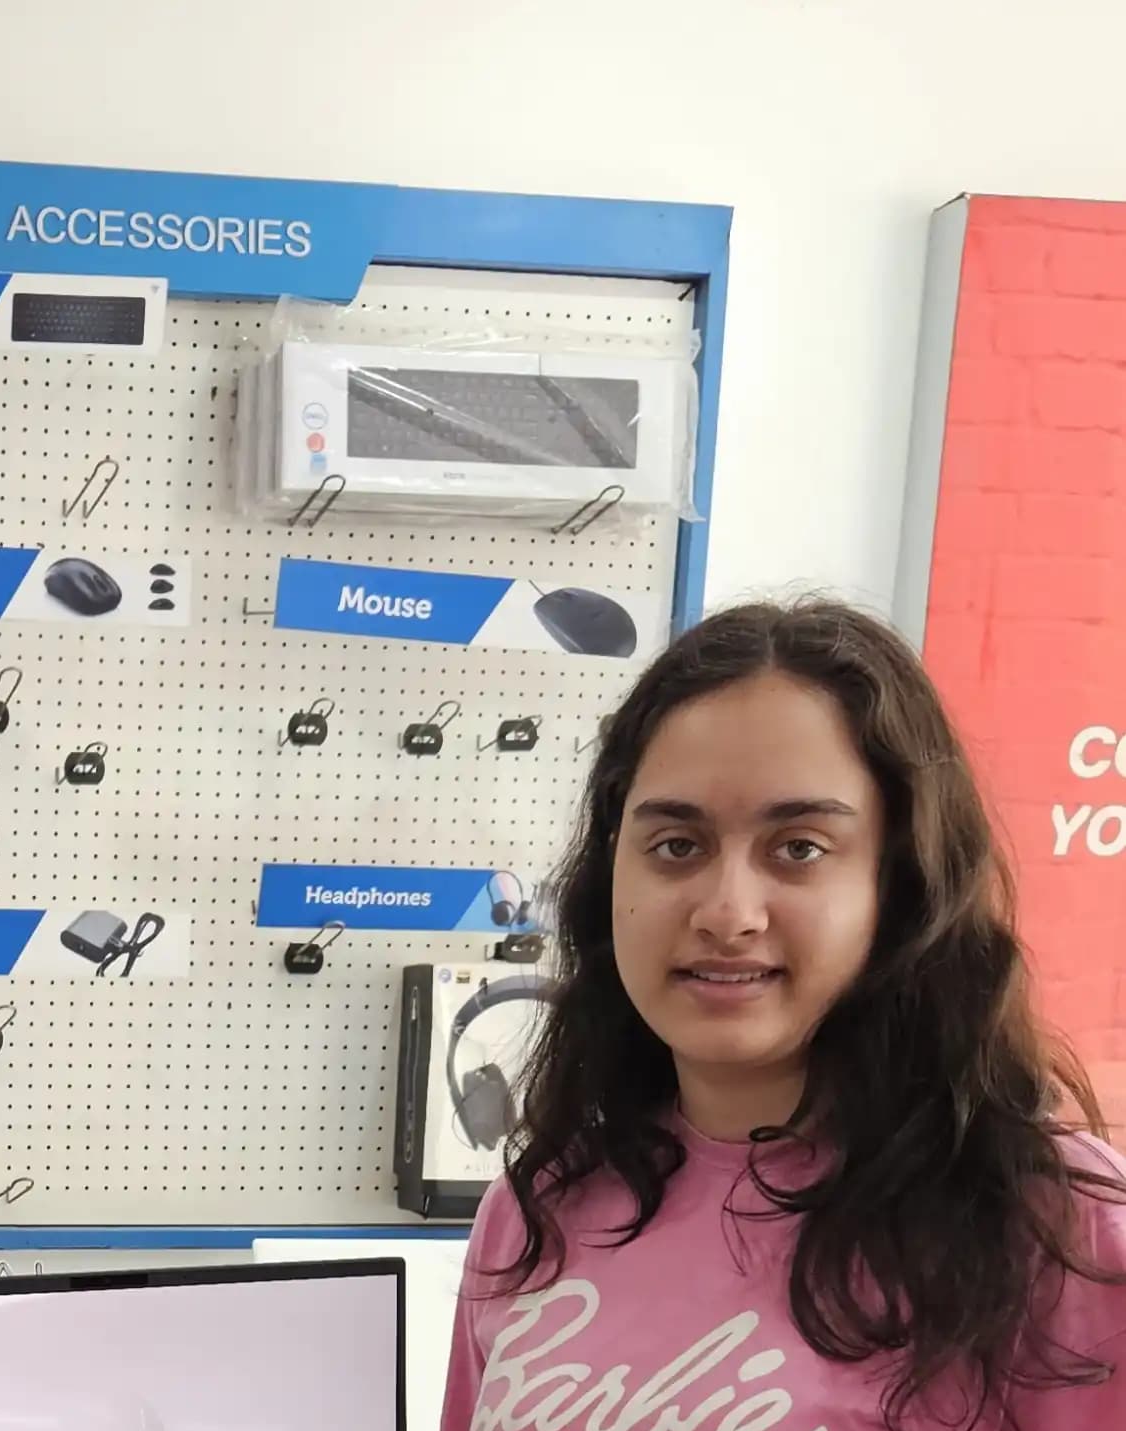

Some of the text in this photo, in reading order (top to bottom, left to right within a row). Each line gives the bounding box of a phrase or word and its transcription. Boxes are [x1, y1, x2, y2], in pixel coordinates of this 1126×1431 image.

[6, 205, 312, 257] ACCESSORIES
[338, 586, 433, 620] Mouse
[1069, 725, 1126, 779] C
[1051, 804, 1126, 856] YO
[305, 886, 432, 909] Headphones
